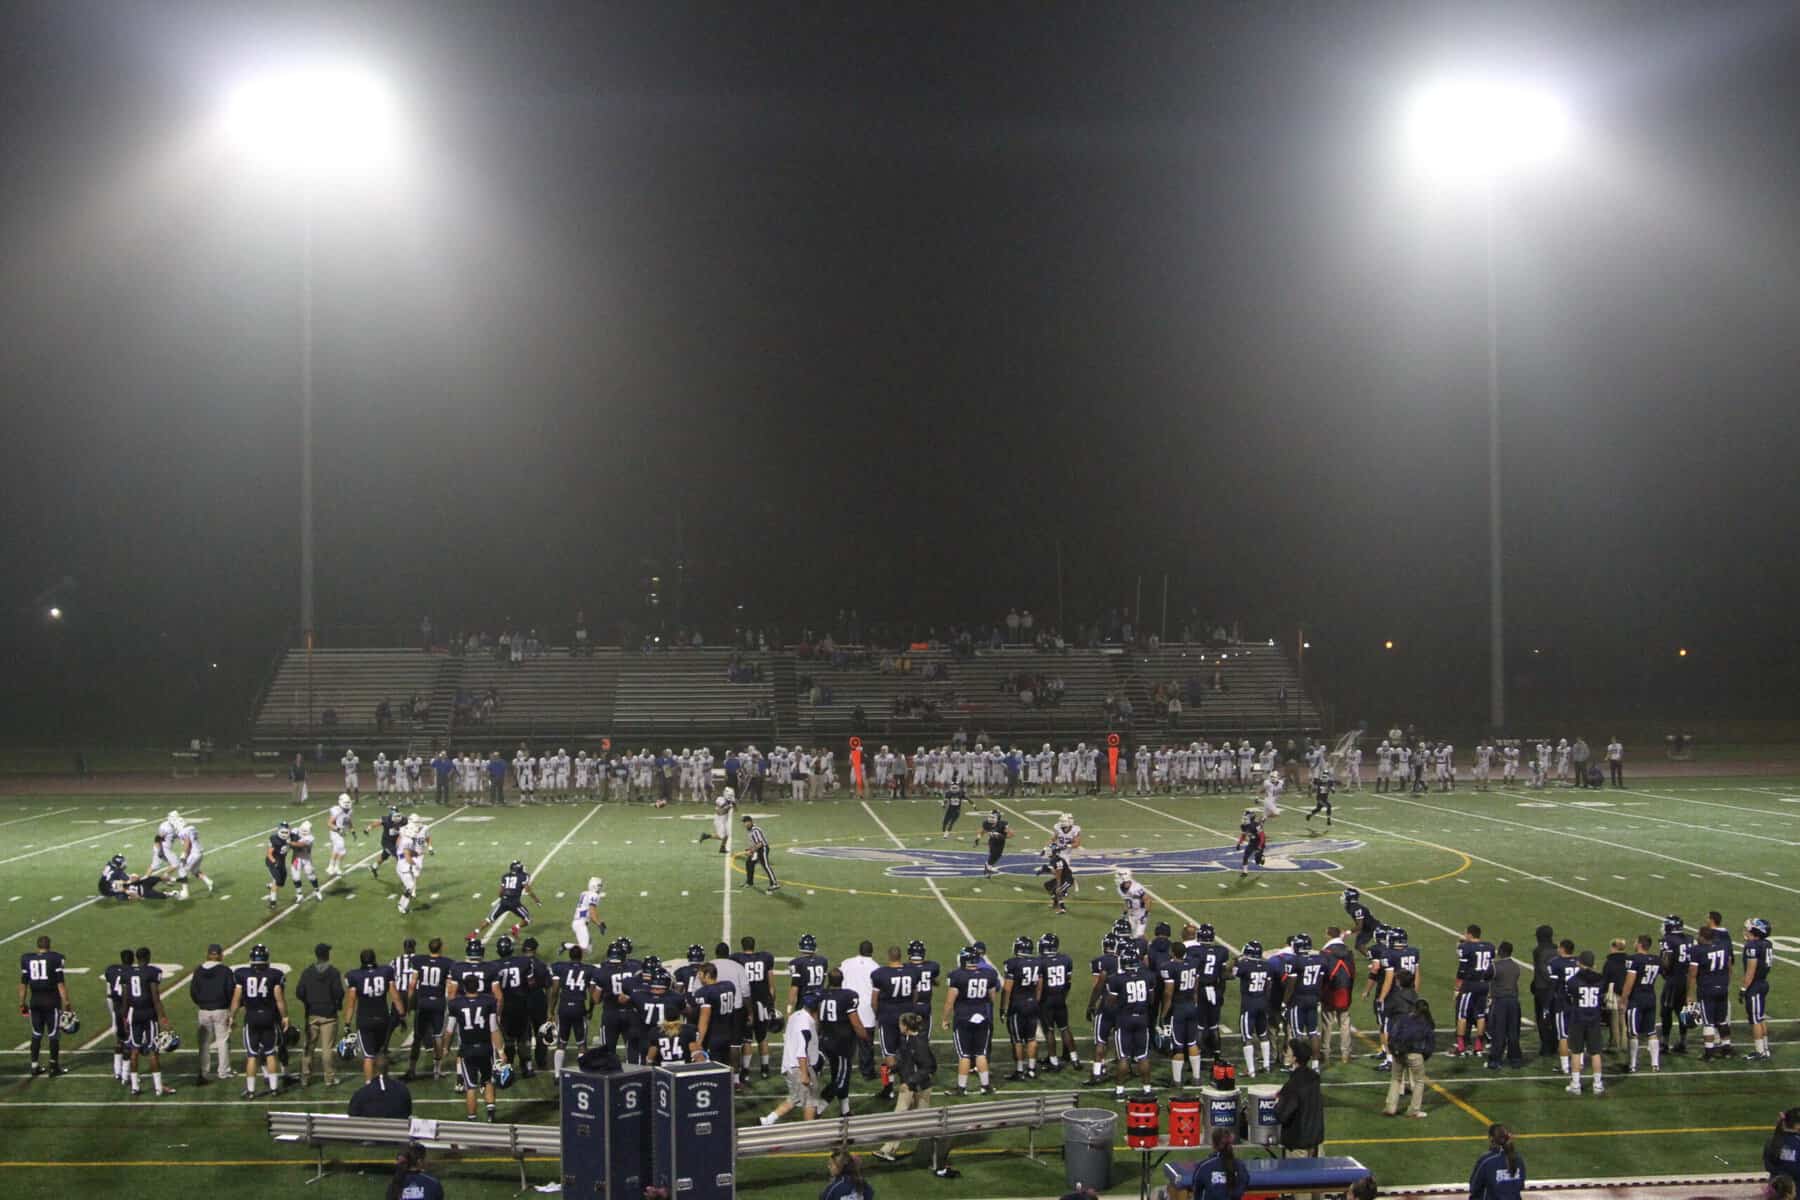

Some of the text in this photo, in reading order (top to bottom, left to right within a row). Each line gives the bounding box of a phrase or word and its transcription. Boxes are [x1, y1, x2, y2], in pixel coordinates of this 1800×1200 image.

[1475, 952, 1491, 971] 16
[1679, 944, 1691, 962] 5
[1708, 950, 1724, 971] 77
[29, 959, 48, 980] 81
[745, 961, 764, 981] 69
[1204, 954, 1216, 974] 2
[1641, 965, 1660, 984] 37
[421, 966, 441, 986] 10
[498, 966, 520, 989] 73
[566, 969, 585, 991] 44
[807, 965, 824, 986] 19
[1180, 968, 1196, 991] 96
[1250, 971, 1266, 992] 35
[1303, 965, 1320, 985] 57
[247, 977, 268, 997] 84
[363, 976, 385, 997] 48
[891, 976, 911, 998] 78
[967, 978, 987, 998] 68
[1126, 980, 1147, 1003] 98
[1578, 986, 1600, 1008] 36
[720, 992, 735, 1016] 60
[461, 1006, 485, 1030] 14
[658, 1036, 683, 1061] 24
[577, 1091, 589, 1111] S
[625, 1090, 637, 1109] S
[696, 1090, 711, 1109] S
